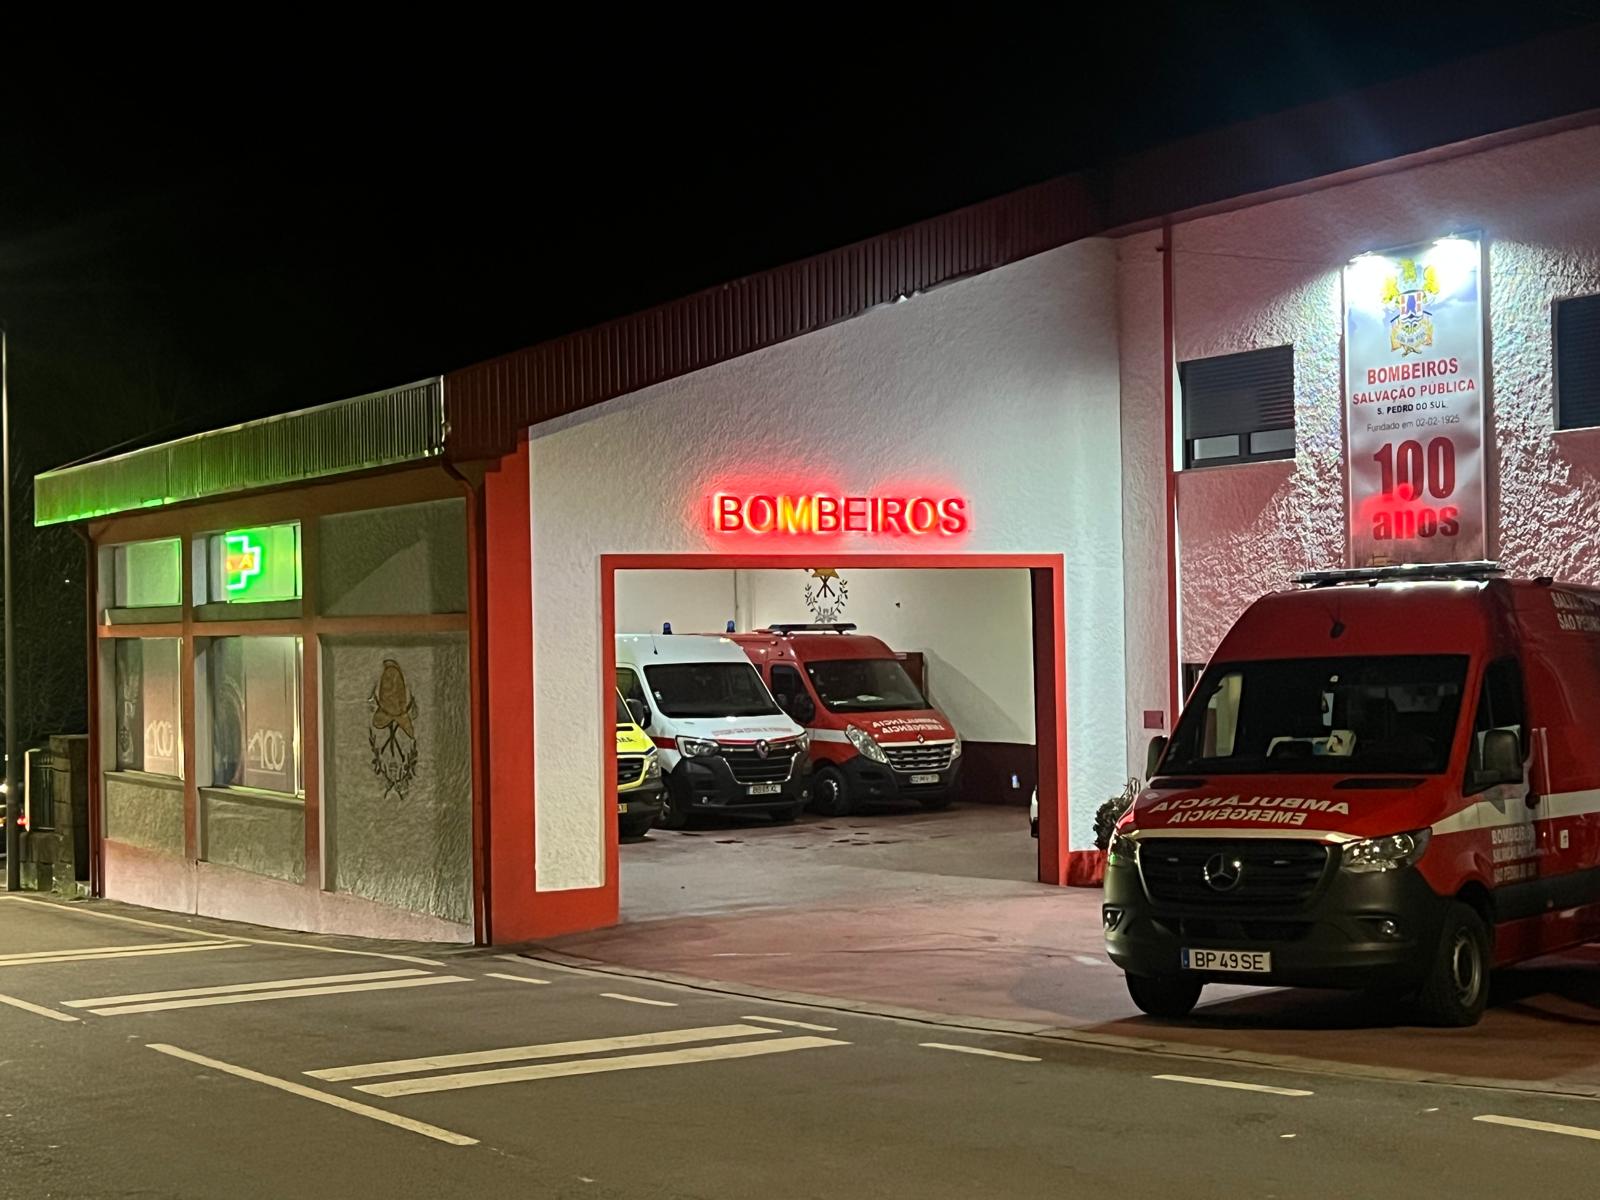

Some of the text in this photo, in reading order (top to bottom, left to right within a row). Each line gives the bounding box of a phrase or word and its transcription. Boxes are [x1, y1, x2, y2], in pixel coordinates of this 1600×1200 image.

[1368, 358, 1458, 384] BOMBEIROS
[1352, 385, 1416, 405] SALVAÇÃO
[1387, 403, 1413, 414] PEDRO
[1416, 402, 1427, 411] DO
[1367, 420, 1400, 432] Fundado
[1416, 414, 1460, 427] 02-02-1925
[1373, 436, 1455, 502] 100
[714, 492, 967, 535] BOMBEIROS
[1372, 507, 1460, 540] anos
[1194, 951, 1264, 970] BP 49 SE
